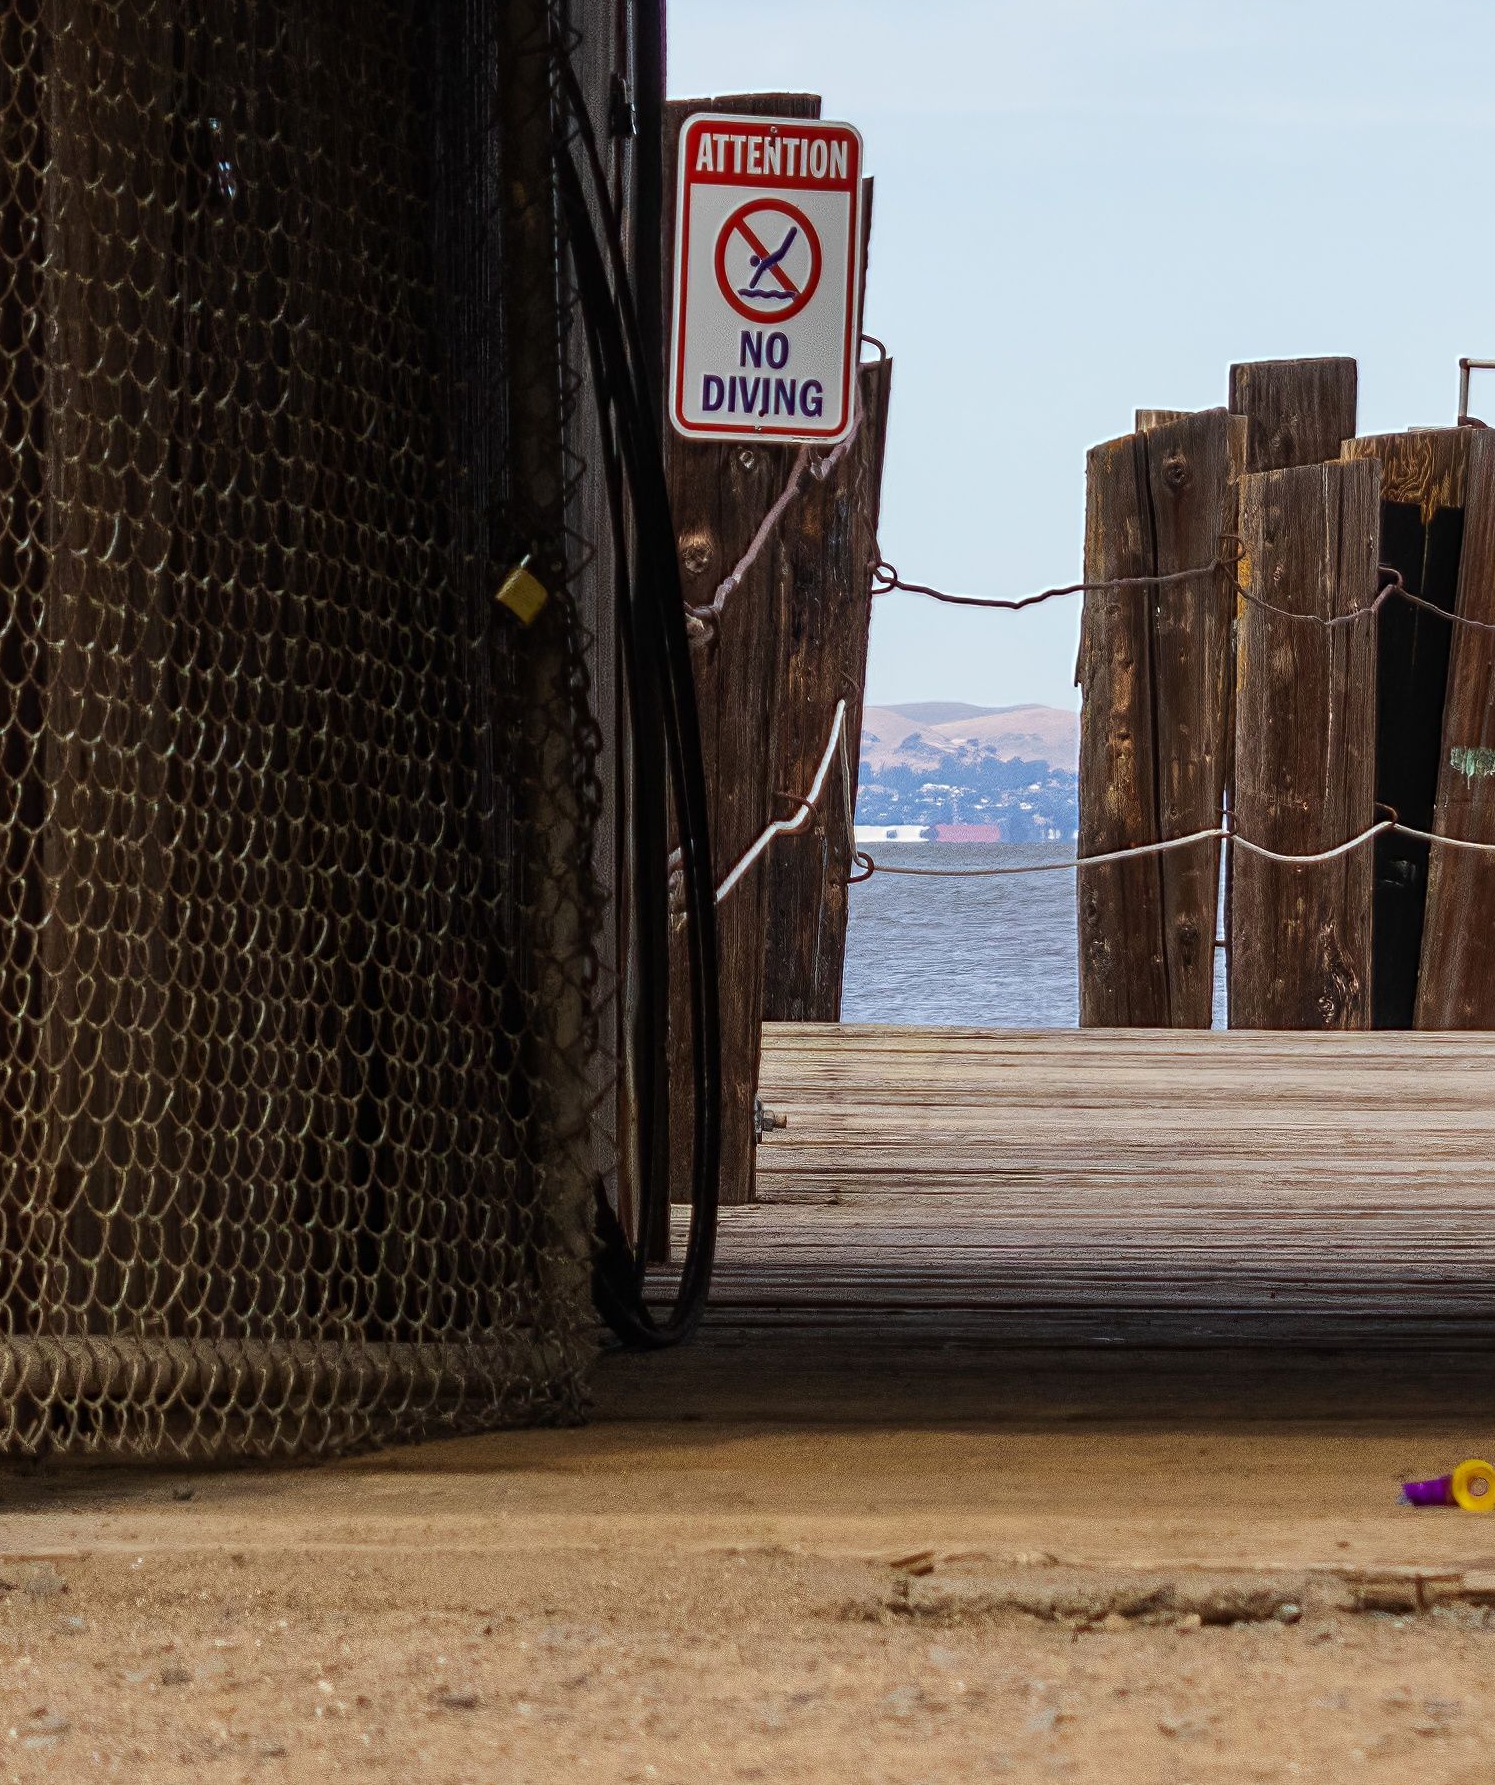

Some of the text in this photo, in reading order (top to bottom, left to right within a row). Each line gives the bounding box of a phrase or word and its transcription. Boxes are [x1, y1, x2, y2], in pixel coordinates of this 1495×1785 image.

[696, 132, 848, 180] ATTENTION
[739, 329, 789, 371] NO
[702, 374, 824, 418] DIVING
